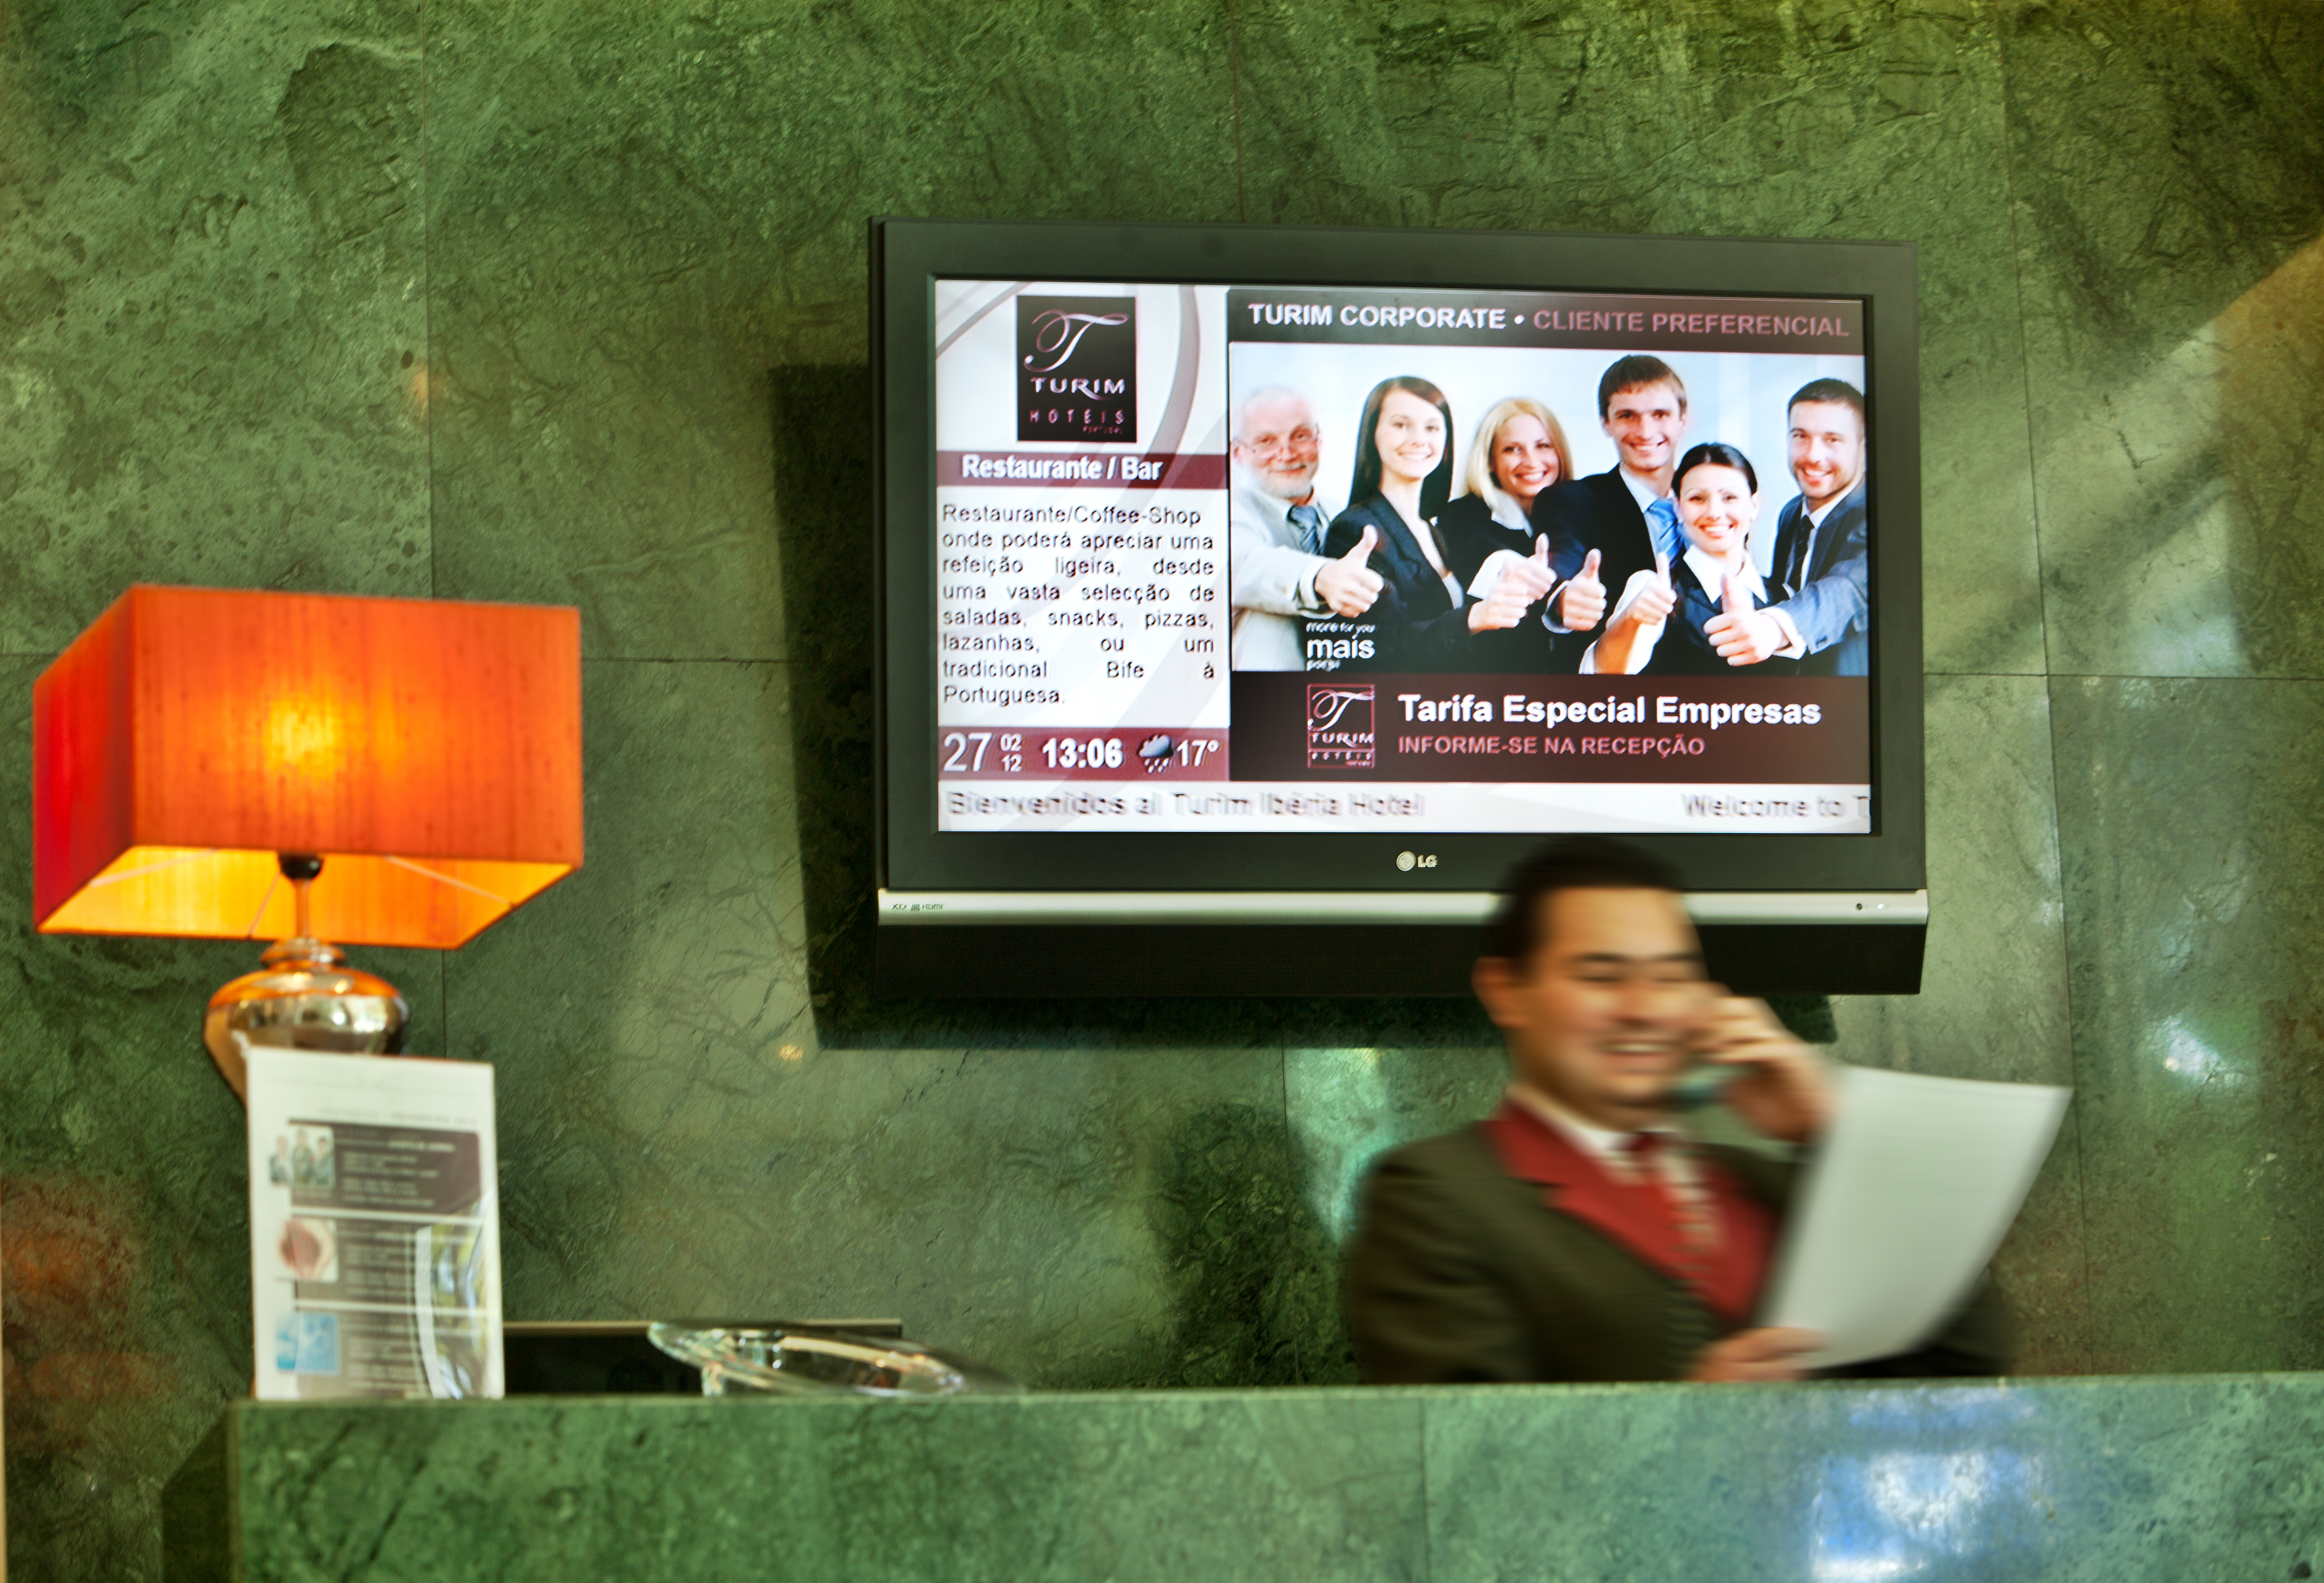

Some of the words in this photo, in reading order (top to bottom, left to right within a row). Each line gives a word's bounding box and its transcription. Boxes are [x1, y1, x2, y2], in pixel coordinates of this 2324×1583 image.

[1248, 303, 1333, 325] TURIM
[1340, 305, 1507, 329] CORPORATE
[1532, 309, 1644, 331] CLIENTE
[1652, 312, 1850, 337] PREFERENCIAL
[1030, 378, 1125, 400] TURIM
[1030, 408, 1125, 424] HOTEIS
[962, 454, 1103, 480] Restaurante
[1121, 456, 1163, 480] Bar
[942, 504, 1201, 528] Restaurante/Coffee-Shop
[942, 532, 992, 548] onde
[1001, 532, 1071, 551] poderá
[1081, 534, 1162, 552] apreciar
[1171, 535, 1214, 550] uma
[942, 556, 1024, 577] refeição
[1056, 557, 1121, 577] ligeira,
[1153, 558, 1214, 575] desde
[942, 586, 986, 600] uma
[1007, 585, 1060, 600] vasta
[1081, 584, 1169, 605] selecção
[1190, 585, 1214, 601] de
[942, 609, 1027, 627] saladas,
[1047, 609, 1123, 628] snacks,
[1145, 610, 1214, 630] pizzas,
[943, 633, 1040, 653] lazanhas,
[1100, 638, 1124, 652] ou
[1184, 638, 1214, 653] um
[1307, 634, 1376, 659] mais
[943, 660, 1047, 677] tradicional
[1106, 661, 1144, 678] Bife
[944, 685, 1065, 707] Portuguesa.
[1397, 694, 1493, 723] Tarifa
[1503, 695, 1645, 729] Especial
[1656, 696, 1821, 729] Empresas
[1000, 733, 1022, 751] 02
[1312, 732, 1374, 748] TURIM
[1398, 736, 1538, 755] INFORME-SE
[1545, 737, 1576, 755] NA
[1581, 733, 1705, 758] RECEPÇÃO
[943, 732, 992, 771] 27
[1042, 737, 1123, 768] 13:06
[1001, 754, 1022, 772] 12
[948, 791, 1126, 816] Bienvenidos
[1171, 793, 1249, 816] Turim
[1348, 793, 1425, 816] Hotel
[1682, 794, 1810, 817] Welcome
[1816, 795, 1845, 818] to
[1418, 855, 1437, 868] LG
